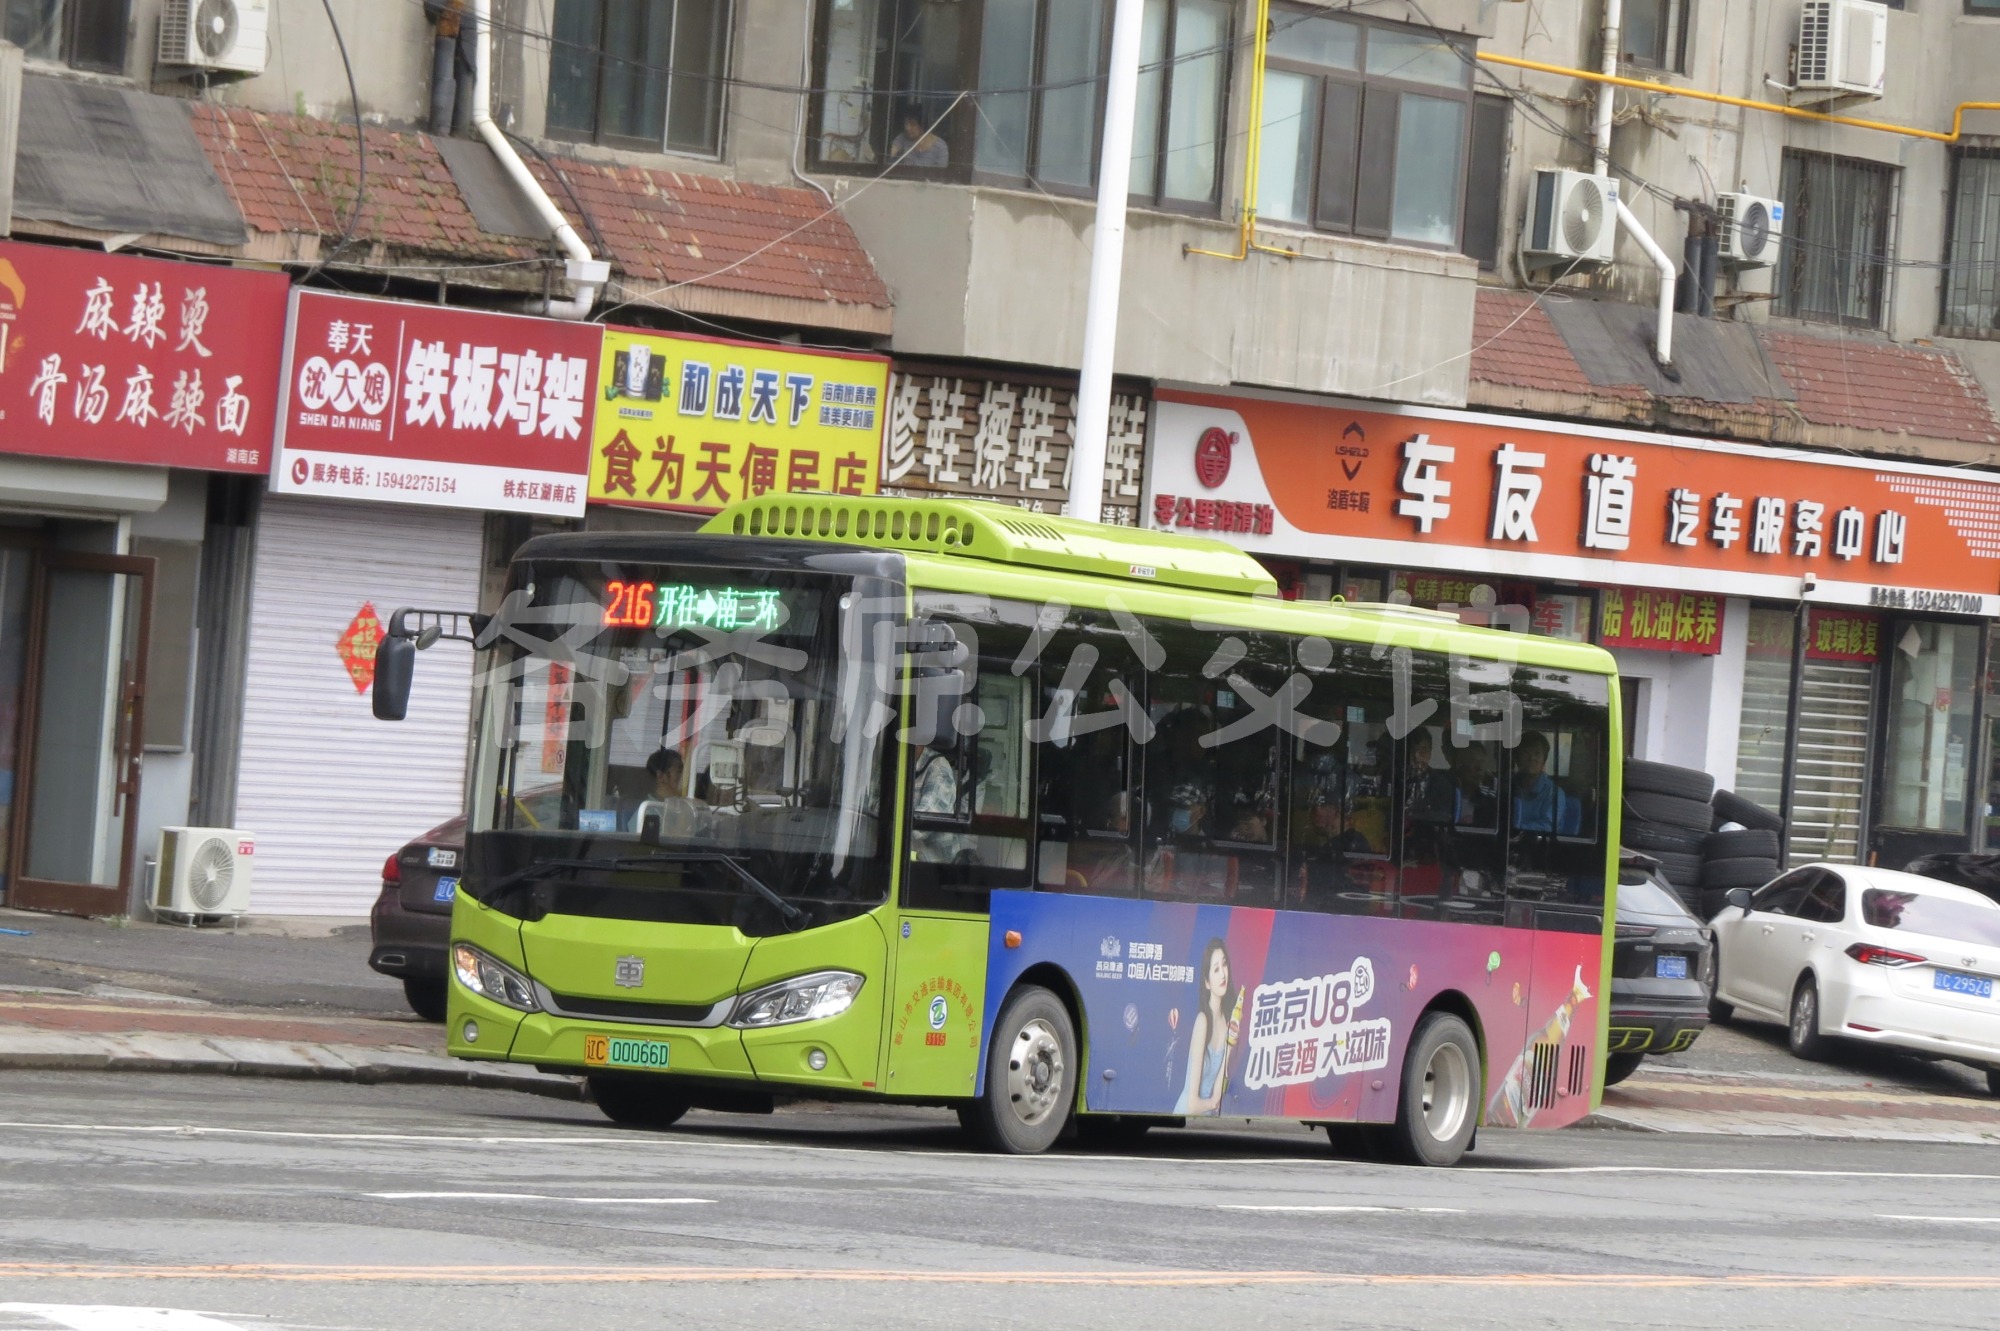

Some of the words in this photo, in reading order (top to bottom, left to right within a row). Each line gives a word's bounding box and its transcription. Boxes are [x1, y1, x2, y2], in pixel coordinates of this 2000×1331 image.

[76, 276, 213, 358] 麻辣烫
[328, 319, 374, 357] 奉天
[29, 353, 251, 437] 骨汤麻辣面
[303, 361, 385, 406] 沈大娘
[404, 338, 588, 441] 铁板鸡架
[679, 360, 815, 427] 和成天下
[299, 412, 328, 427] SHEN
[332, 414, 346, 428] DA
[348, 415, 382, 432] NIANG
[882, 372, 1146, 498] 修鞋擦鞋鞋
[601, 428, 868, 503] 食为天便民店
[503, 479, 578, 504] 铁东区湖南店
[1154, 494, 1275, 536] 零公里润滑油
[1399, 433, 1637, 551] 车友道
[1669, 487, 1907, 564] 汽车服务中心
[604, 581, 655, 627] 216
[657, 585, 699, 628] 开往
[717, 586, 781, 630] 南三环
[1602, 588, 1625, 638] 胎
[1630, 590, 1718, 646] 机油保养
[1816, 617, 1879, 656] 玻璃修复
[1127, 962, 1194, 983] 中国人自己的啤酒
[1128, 942, 1163, 961] 燕京啤酒
[1253, 980, 1352, 1039] 燕京U8
[926, 1032, 946, 1046] 3115
